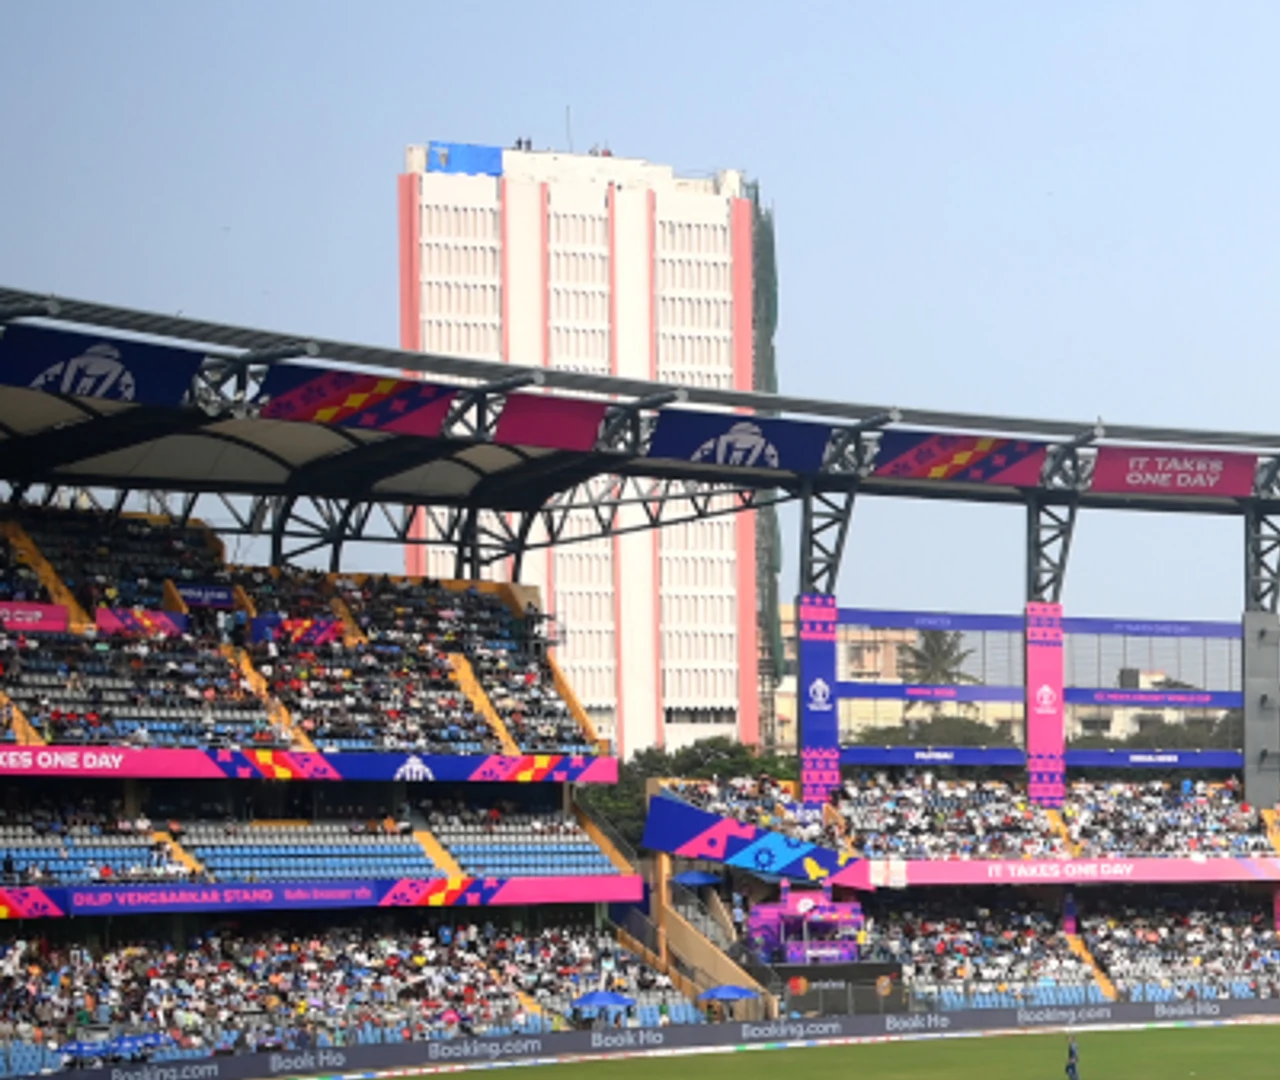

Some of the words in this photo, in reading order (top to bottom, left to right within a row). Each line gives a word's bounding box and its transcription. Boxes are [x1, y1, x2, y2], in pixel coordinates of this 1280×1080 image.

[1129, 456, 1149, 471] IT
[1155, 457, 1224, 472] TAKES
[1126, 472, 1172, 487] ONE
[1177, 473, 1219, 487] DAY
[36, 751, 80, 769] ONE
[83, 752, 124, 769] DAY
[988, 863, 1002, 877] IT
[1008, 863, 1060, 877] TAKES
[1064, 863, 1098, 877] ONE
[1101, 863, 1135, 877] DAY
[223, 887, 275, 904] STAND
[591, 1031, 636, 1049] Book
[638, 1030, 664, 1045] Ho
[741, 1020, 842, 1042] Booking.com
[428, 1037, 541, 1060] Booking.com
[270, 1053, 316, 1073] Book
[318, 1052, 347, 1068] Ho
